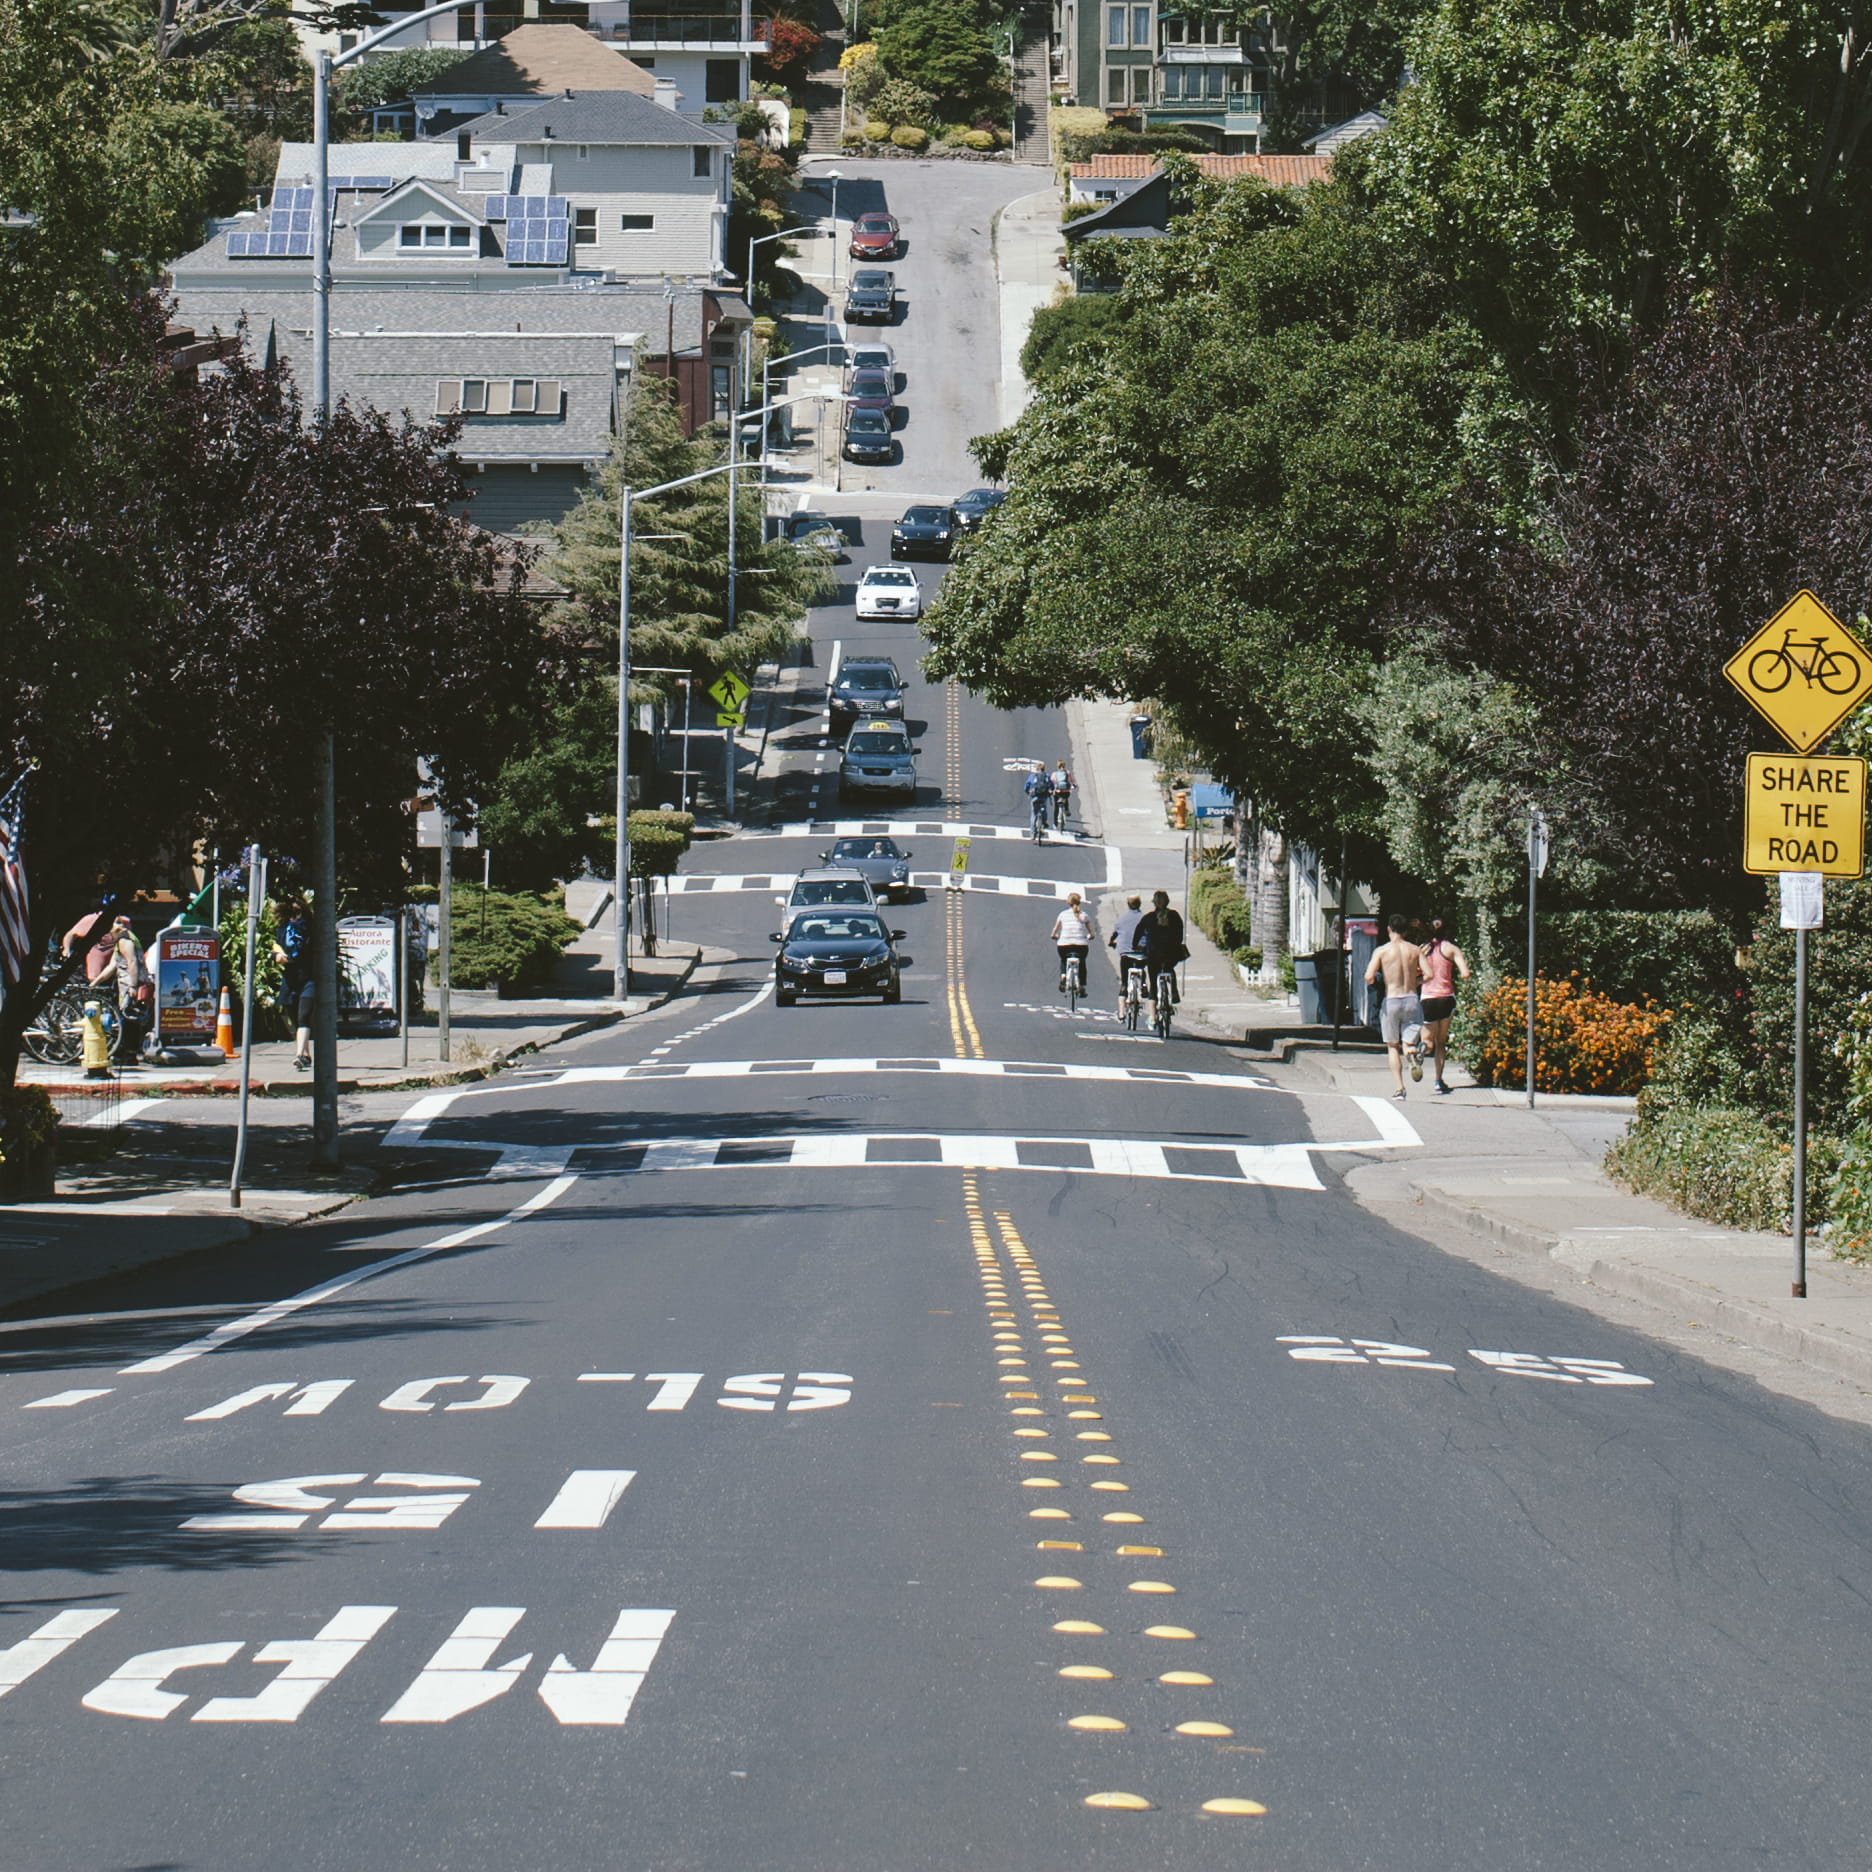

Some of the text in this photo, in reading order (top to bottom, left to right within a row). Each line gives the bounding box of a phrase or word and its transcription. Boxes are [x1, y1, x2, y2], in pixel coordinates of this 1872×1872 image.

[1761, 766, 1850, 794] SHARE
[1780, 803, 1829, 829] THE
[1768, 837, 1839, 865] ROAD
[170, 943, 210, 952] BIKERS
[351, 929, 383, 938] Aurora
[170, 949, 210, 959] SPECIAL
[1276, 1336, 1655, 1385] 25
[184, 1371, 855, 1422] SLOW
[178, 1469, 639, 1531] 15
